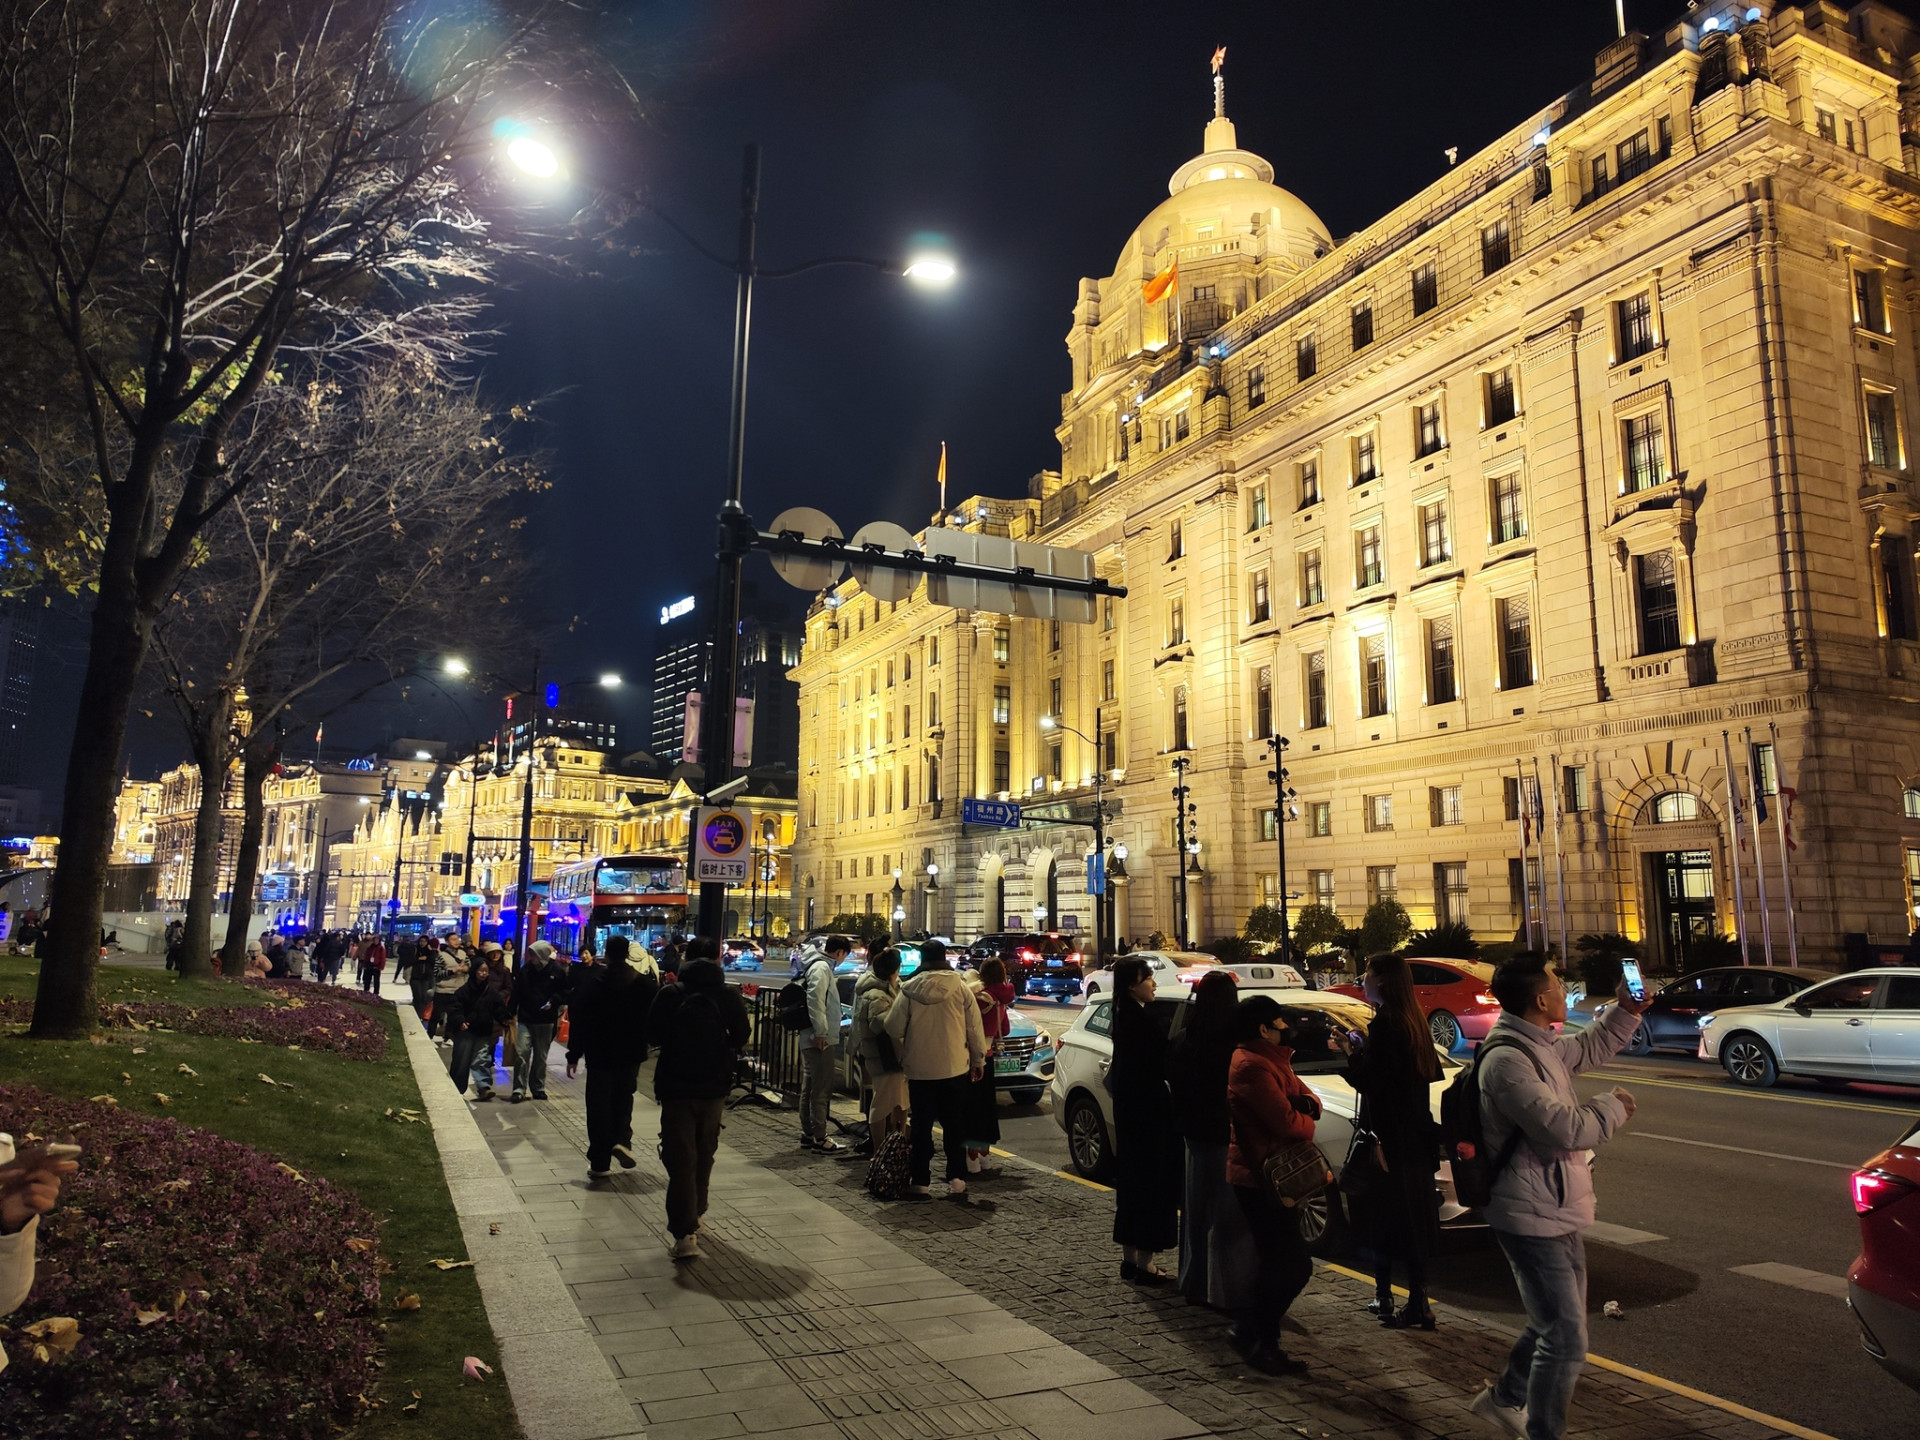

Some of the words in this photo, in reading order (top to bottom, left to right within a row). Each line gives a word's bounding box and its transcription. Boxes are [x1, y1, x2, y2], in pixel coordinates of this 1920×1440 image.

[977, 804, 1004, 816] 福州路
[715, 820, 736, 828] TAXI
[701, 863, 743, 877] 临时上下客
[1282, 971, 1301, 983] 江
[997, 1059, 1020, 1071] 5003
